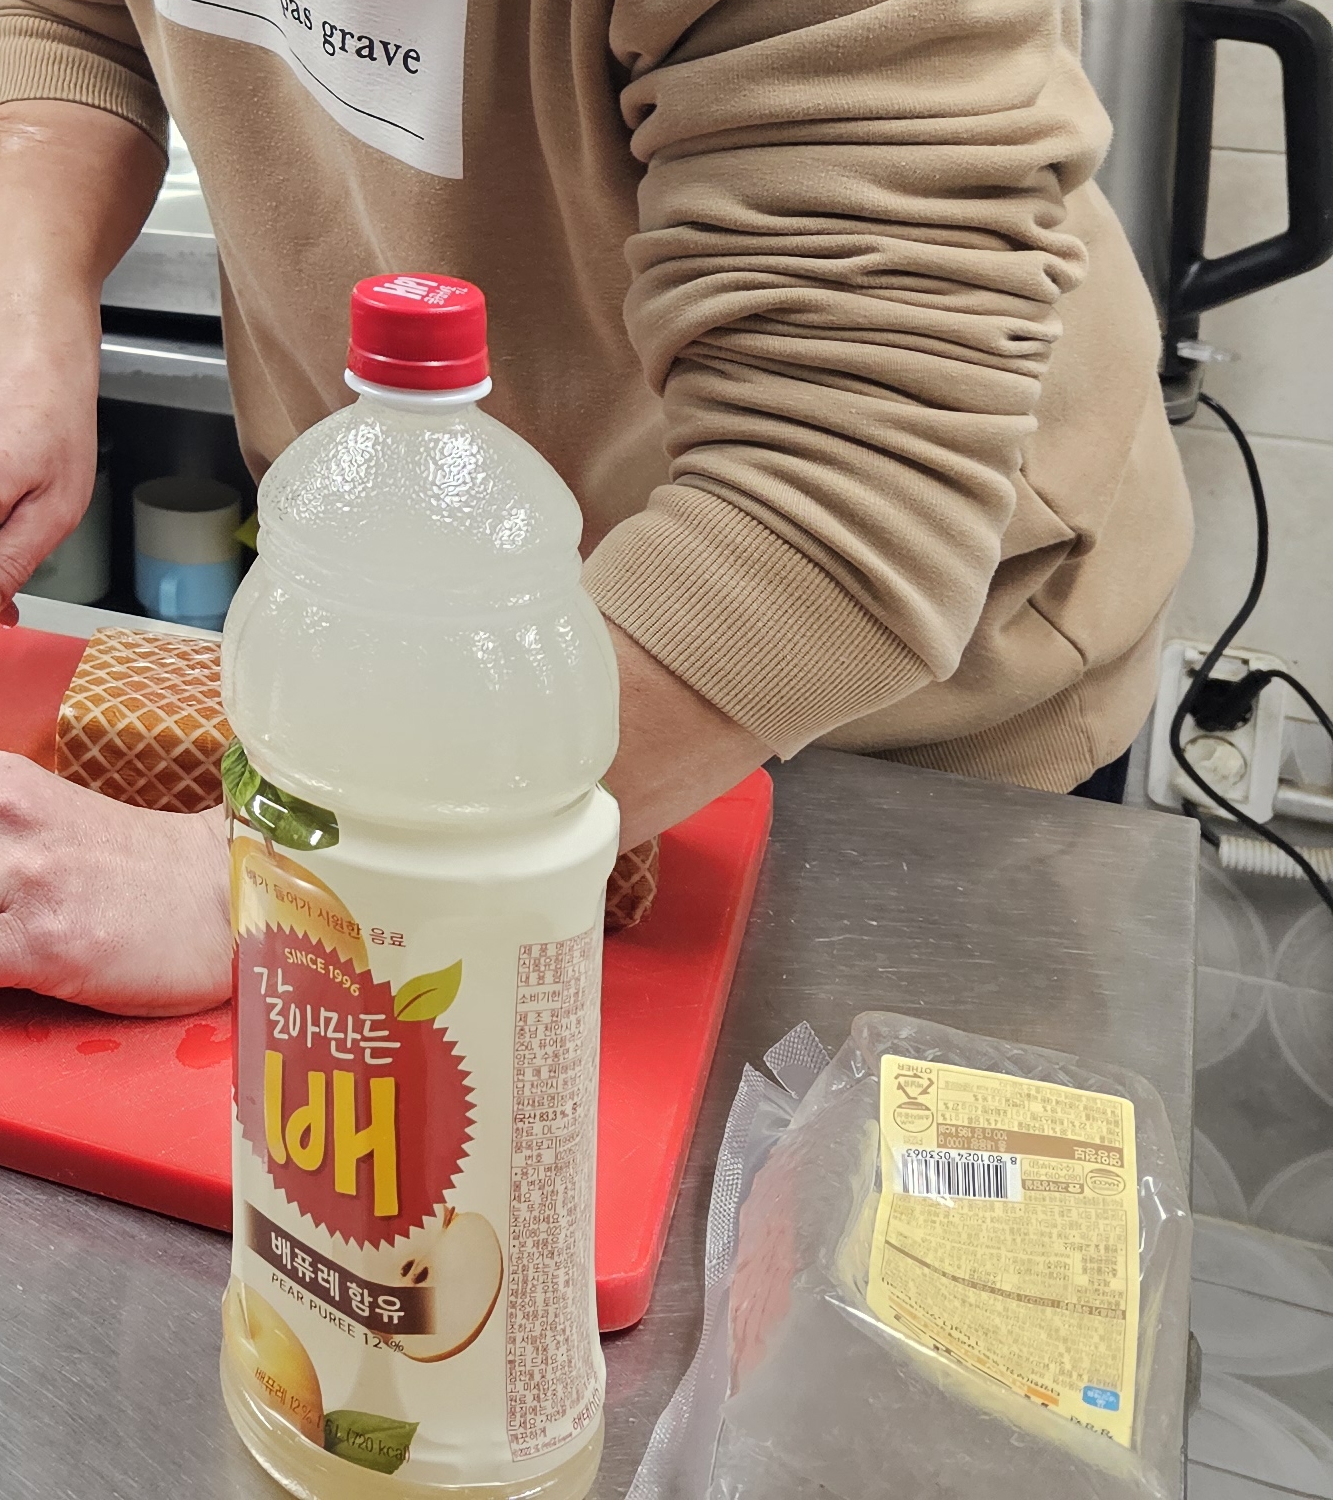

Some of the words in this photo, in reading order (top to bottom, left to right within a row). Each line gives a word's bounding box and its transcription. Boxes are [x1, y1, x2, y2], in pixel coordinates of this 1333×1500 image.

[321, 20, 422, 76] grave
[245, 866, 269, 894] 배가
[273, 883, 313, 918] 들어가
[317, 907, 362, 940] 시원한
[369, 927, 407, 948] 음료
[284, 948, 326, 974] SINCE
[328, 965, 361, 997] 1996
[519, 990, 560, 1004] 소비기한
[253, 966, 401, 1065] 갈아만든
[518, 1026, 537, 1039] 충남
[544, 1021, 571, 1037] 천안시
[516, 1052, 537, 1066] 양군
[897, 1063, 932, 1074] OTHER
[516, 1083, 525, 1095] 남
[531, 1080, 558, 1094] 천안시
[516, 1095, 555, 1111] 원재료명
[539, 1110, 557, 1122] 83.3
[264, 1049, 398, 1217] 배
[939, 1125, 955, 1135] kcal
[957, 1126, 972, 1136] 195
[974, 1128, 983, 1137] 당
[994, 1130, 1007, 1139] 100
[515, 1138, 553, 1153] 품목보고
[970, 1138, 995, 1151] 내용량
[525, 1152, 543, 1165] 번호
[905, 1149, 951, 1160] 053063
[1010, 1156, 1017, 1165] 8
[1073, 1147, 1121, 1166] 영양정보
[1023, 1170, 1081, 1182] 080-019-9119
[1025, 1181, 1066, 1192] 고객상담실
[1091, 1179, 1119, 1188] HACCP
[541, 1189, 558, 1202] 심한
[533, 1236, 559, 1250] 제품은
[511, 1263, 529, 1275] 교환
[533, 1262, 551, 1273] 또는
[271, 1231, 340, 1302] 배퓨레
[346, 1281, 405, 1325] 함유
[510, 1287, 538, 1299] 제품은
[271, 1272, 305, 1306] PEAR
[309, 1300, 357, 1339] PUREE
[362, 1332, 383, 1350] 12
[389, 1339, 405, 1353] %
[510, 1322, 535, 1334] 조하고
[508, 1346, 526, 1356] 시고
[254, 1367, 288, 1407] 배퓨레
[510, 1426, 547, 1445] 깨끗하게
